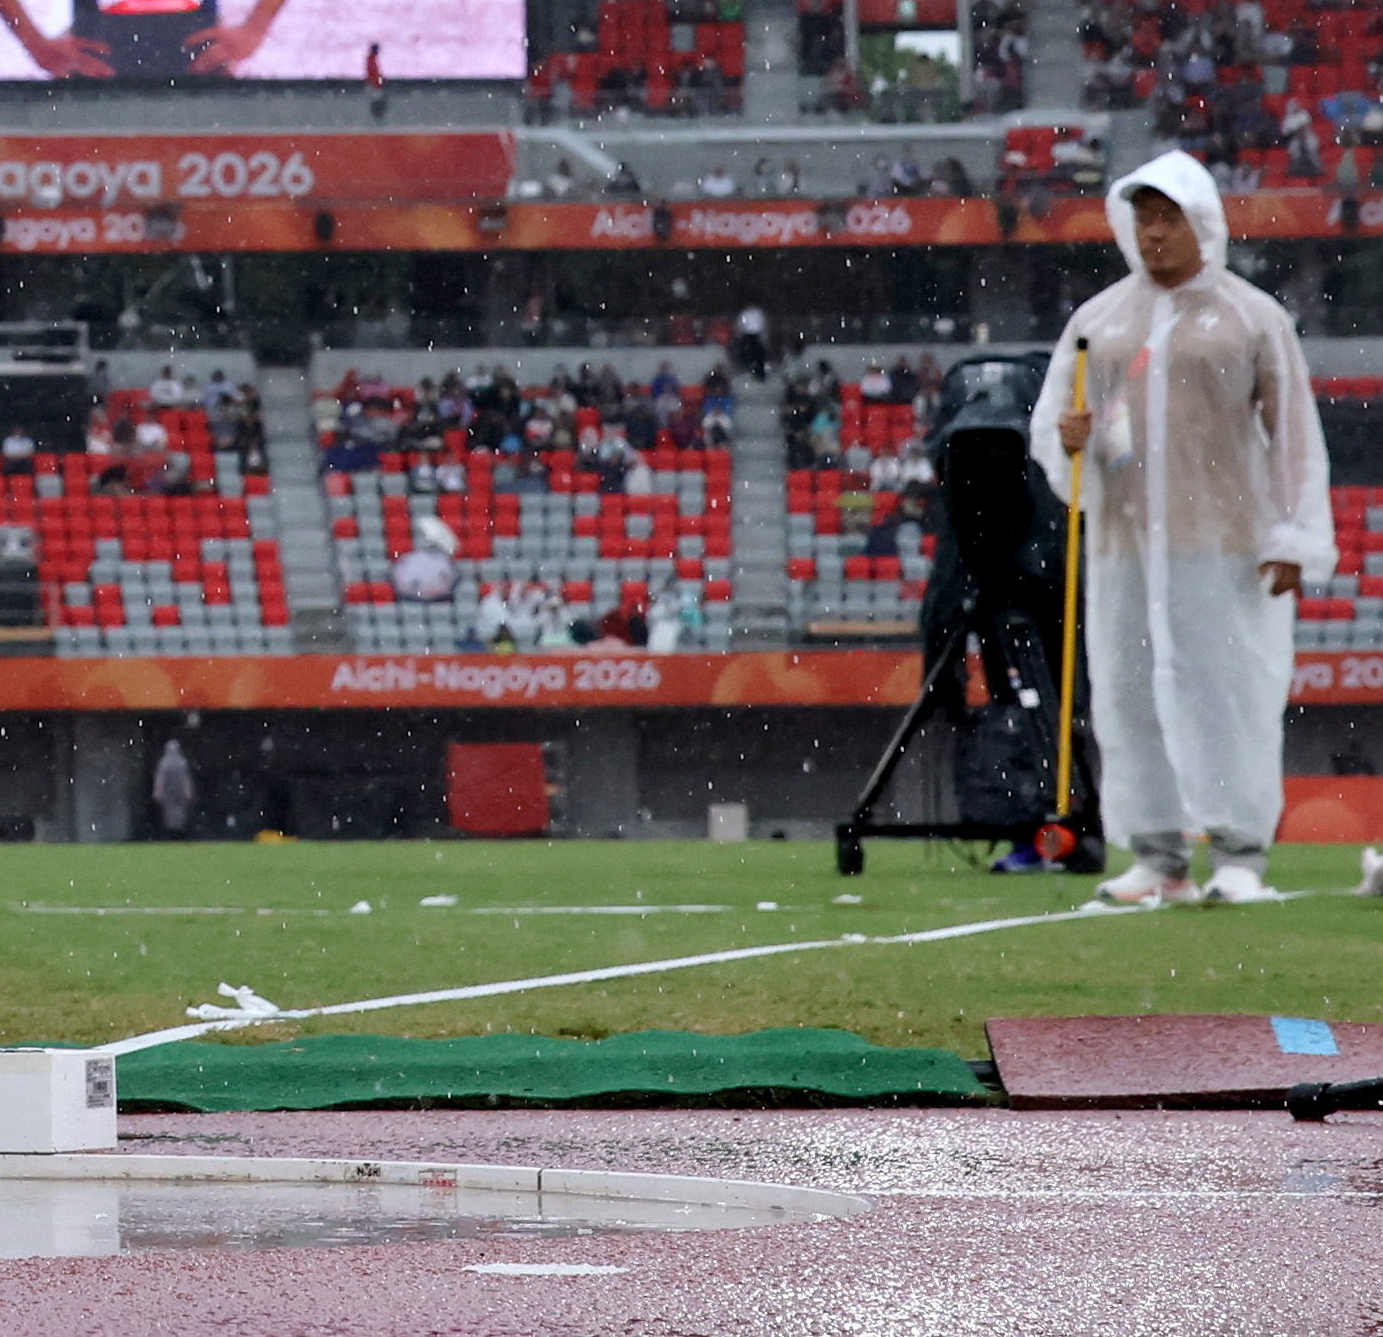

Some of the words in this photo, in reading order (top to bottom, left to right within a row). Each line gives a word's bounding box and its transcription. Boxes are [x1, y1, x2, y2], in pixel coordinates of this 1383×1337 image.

[176, 151, 315, 198] 2026
[845, 204, 913, 235] 026
[331, 660, 567, 698] Aichi-Nagoya
[573, 661, 662, 691] 2026
